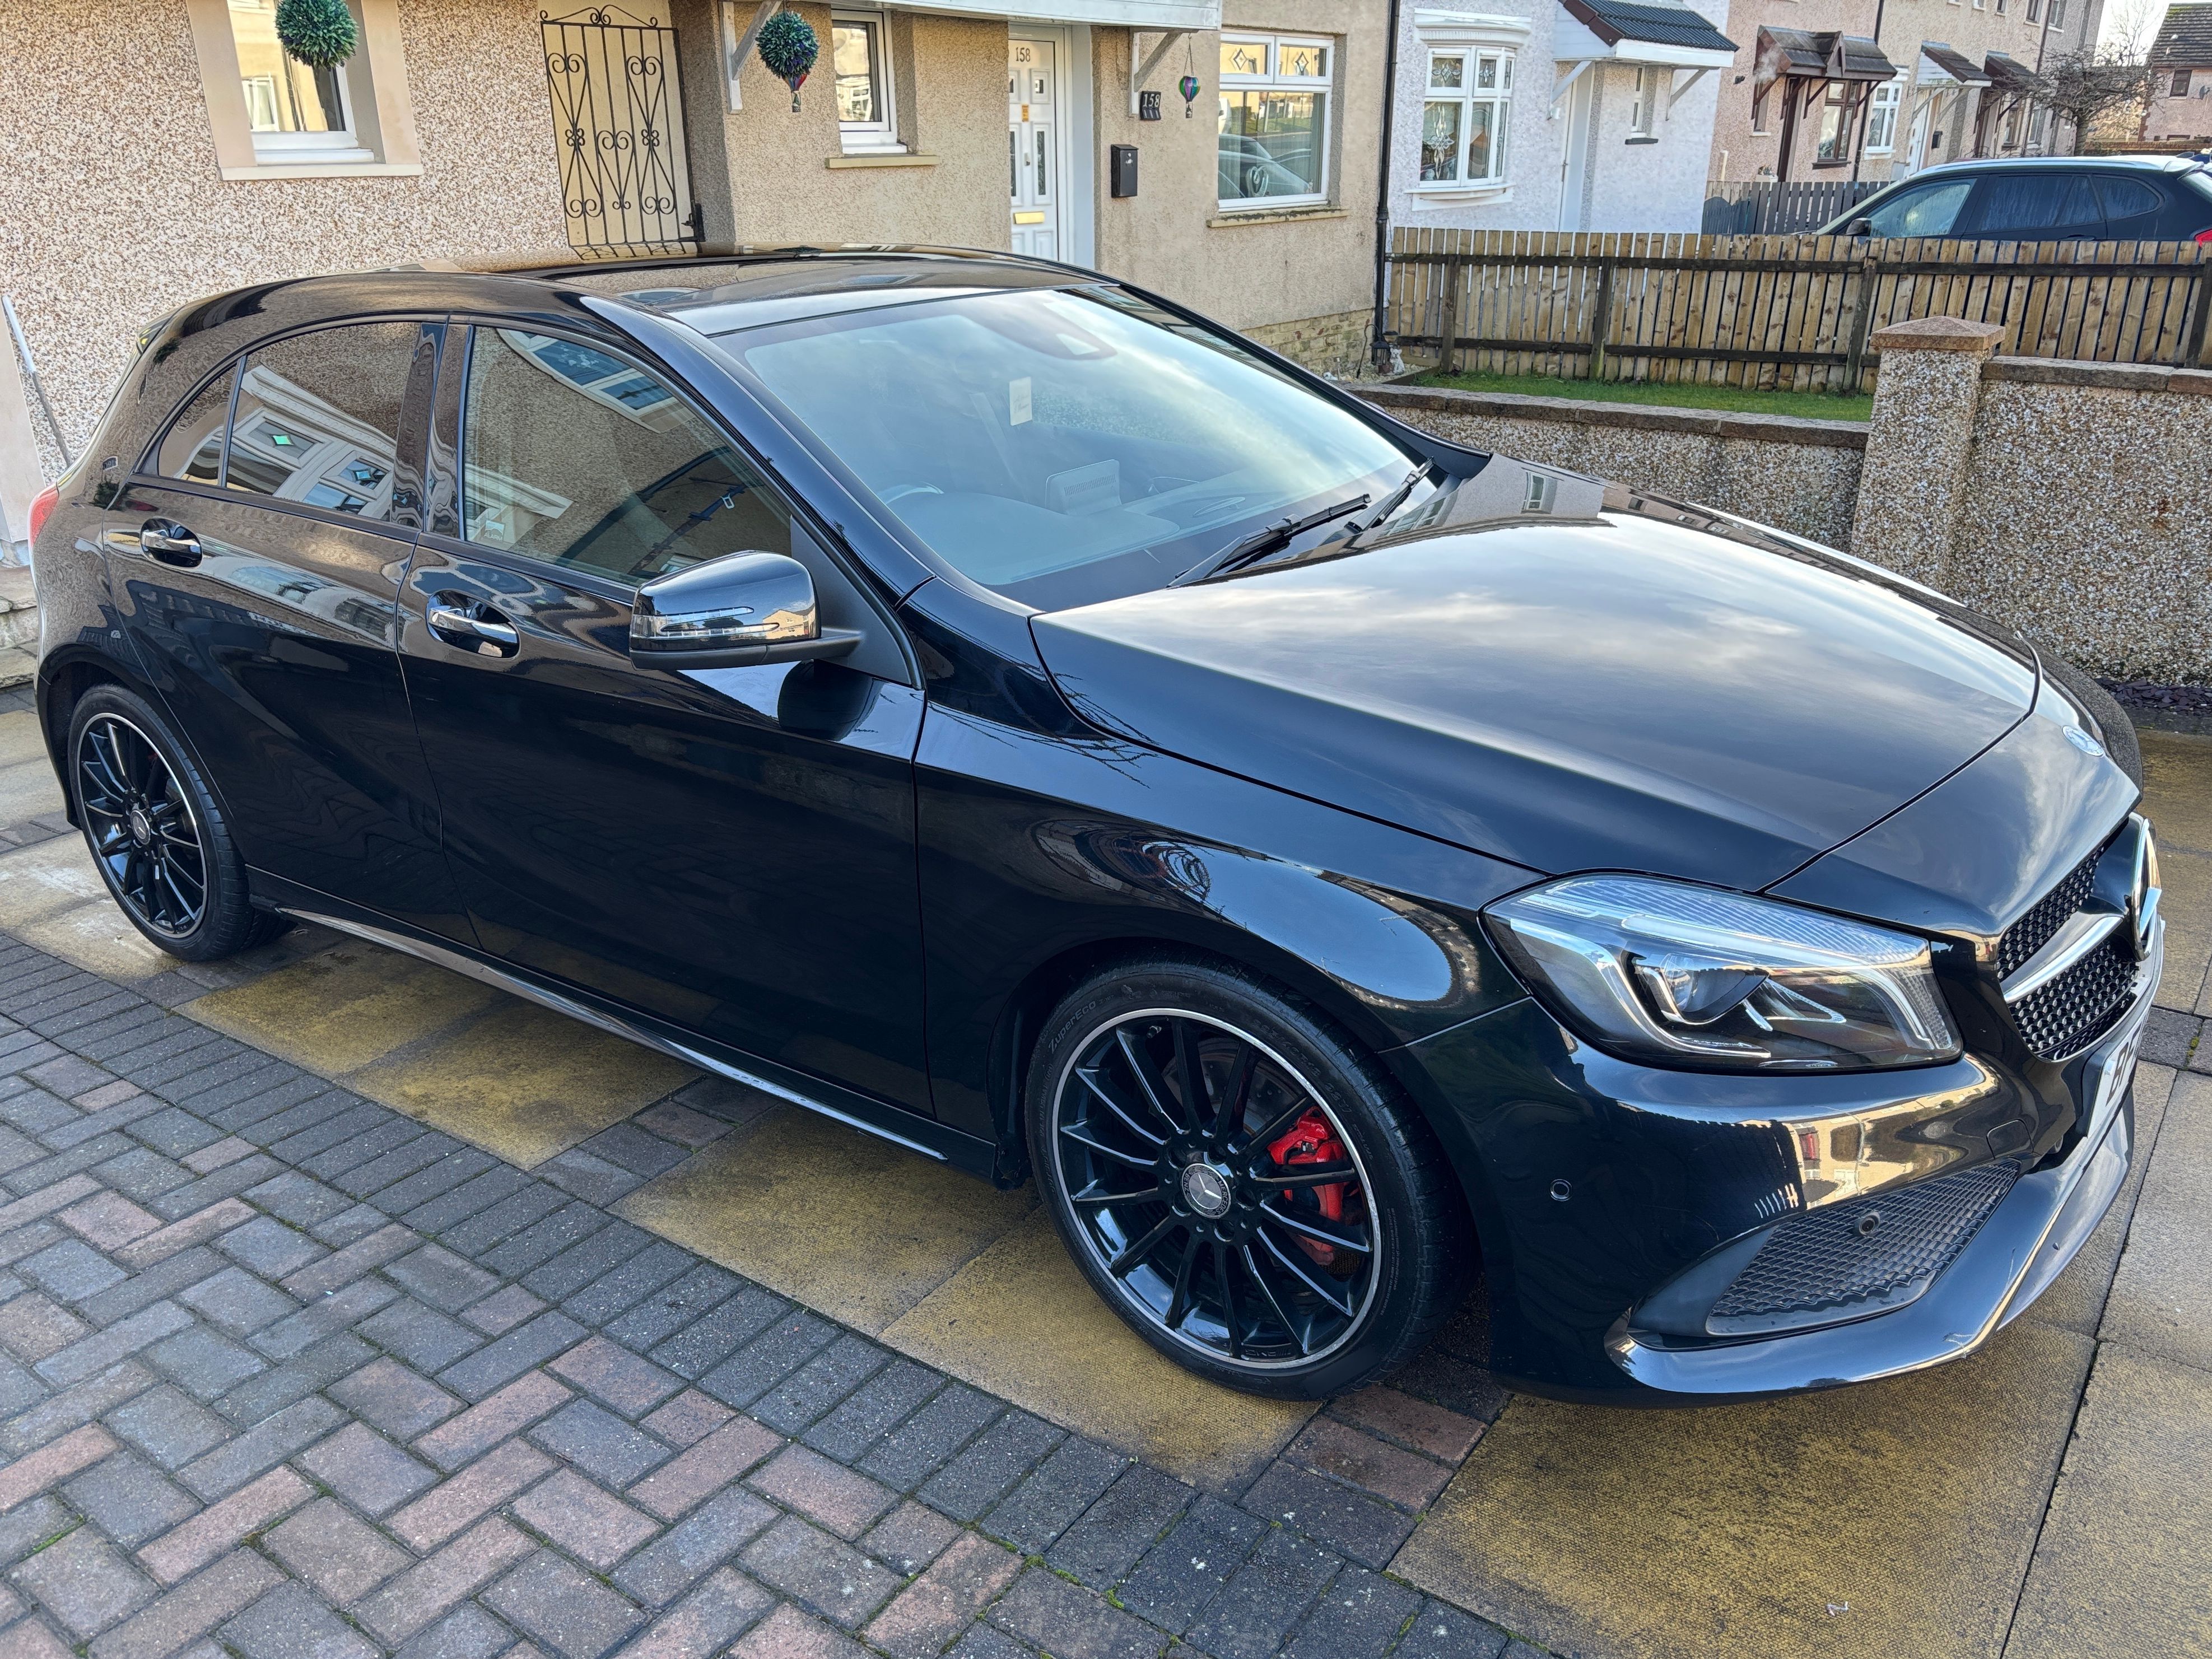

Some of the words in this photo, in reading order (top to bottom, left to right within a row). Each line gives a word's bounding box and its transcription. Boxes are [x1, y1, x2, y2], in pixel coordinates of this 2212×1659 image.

[1016, 47, 1031, 62] 158
[1143, 94, 1159, 108] 158
[484, 532, 502, 541] ALARM
[1049, 1000, 1096, 1054] ZuperEco
[1216, 1180, 1228, 1214] MERCEDES
